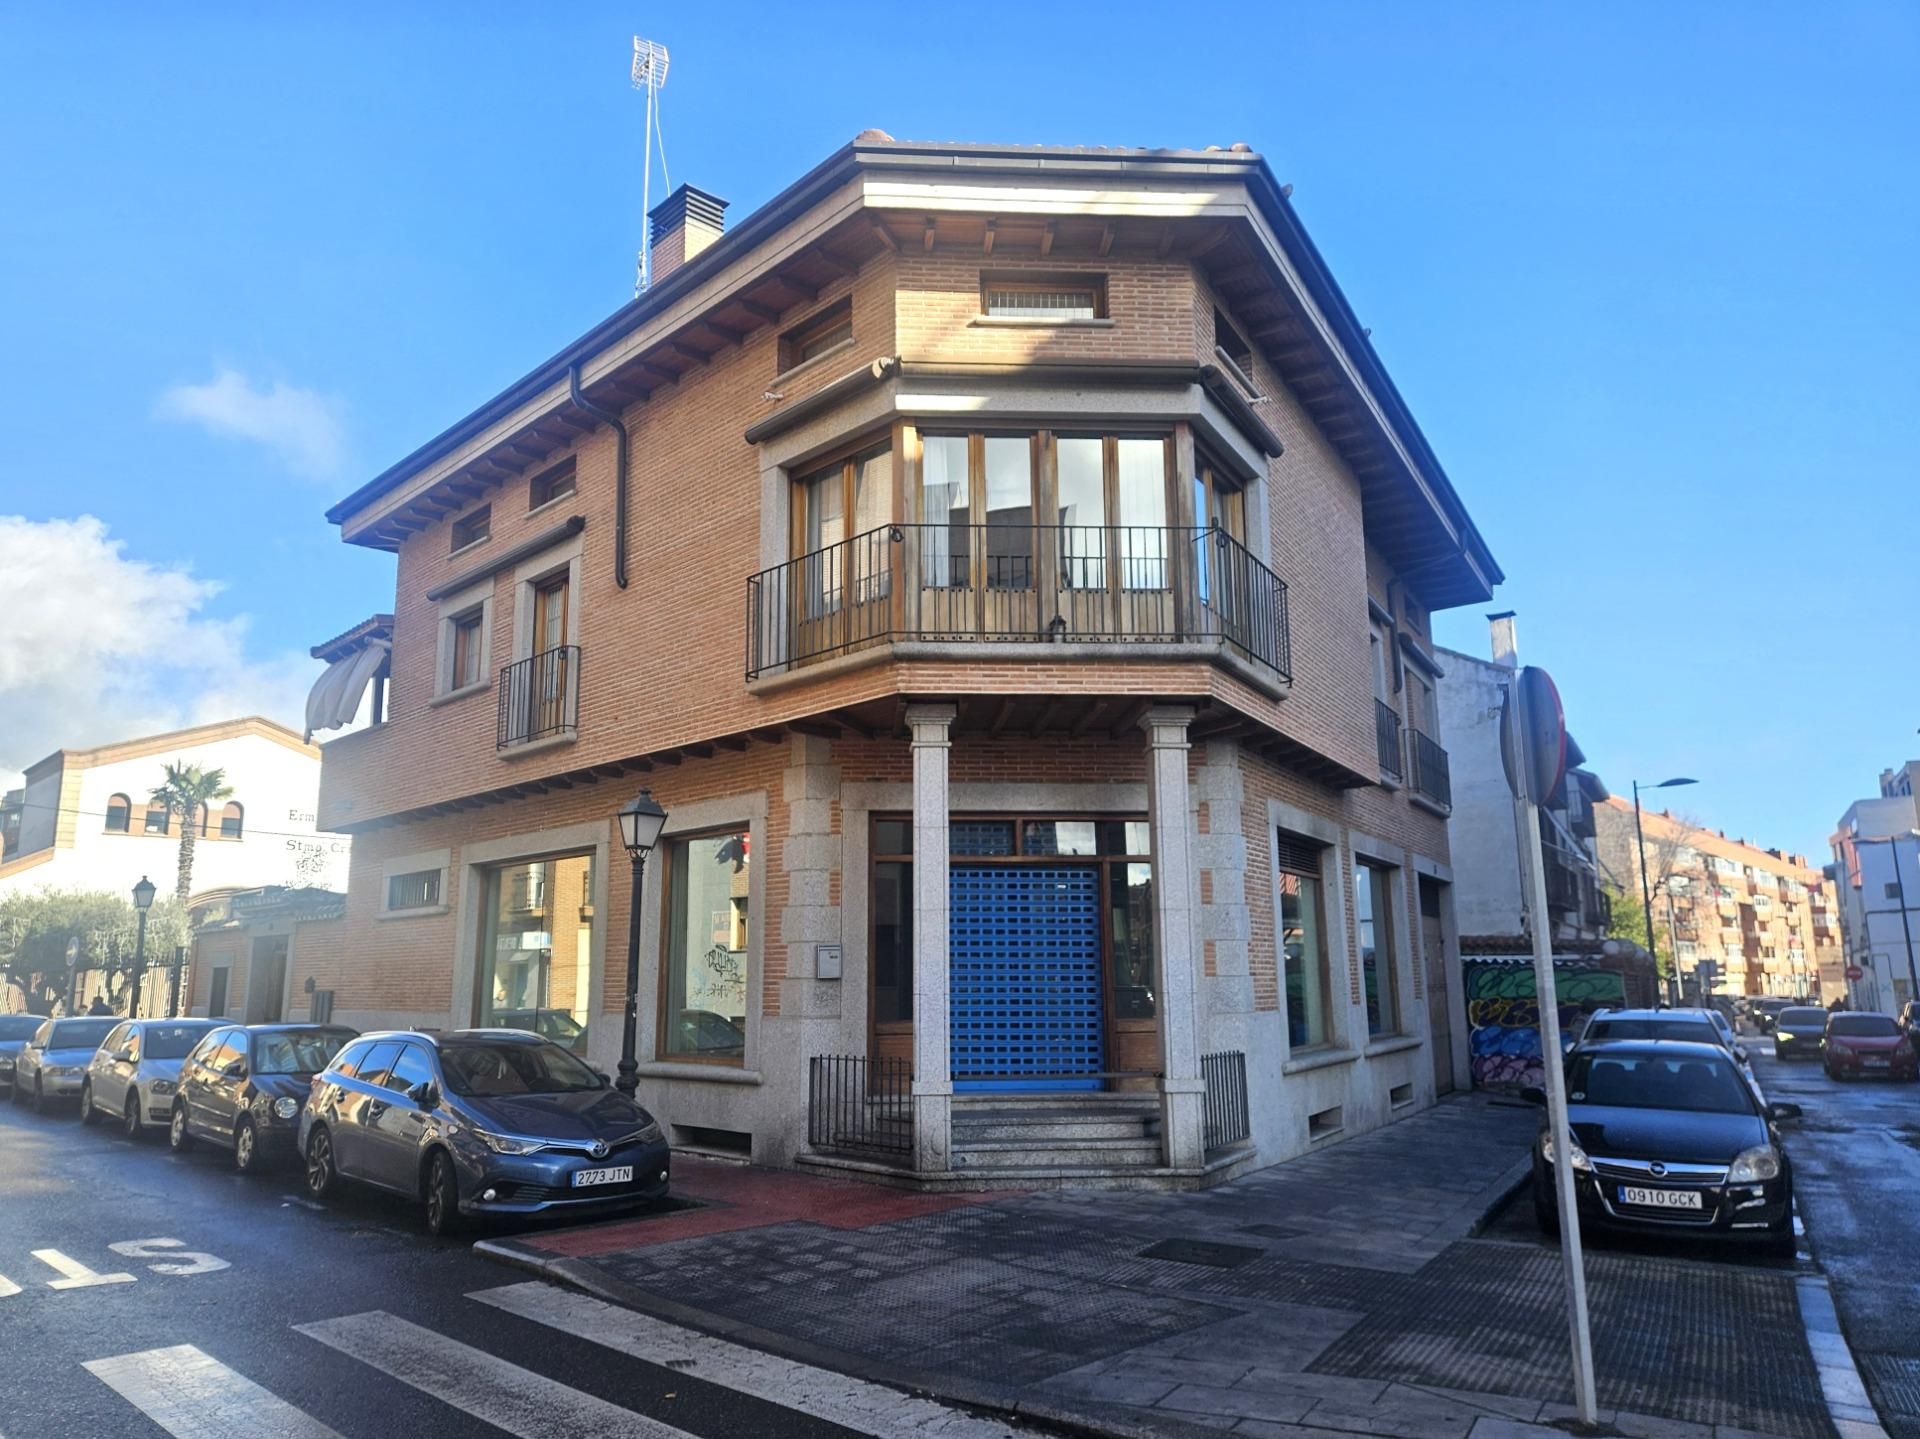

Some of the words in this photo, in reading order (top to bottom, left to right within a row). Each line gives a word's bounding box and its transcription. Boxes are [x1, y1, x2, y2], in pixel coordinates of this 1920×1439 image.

[578, 1170, 606, 1185] 2773
[609, 1168, 630, 1181] JTN
[1627, 1189, 1665, 1204] 0910
[1668, 1193, 1696, 1206] GCK
